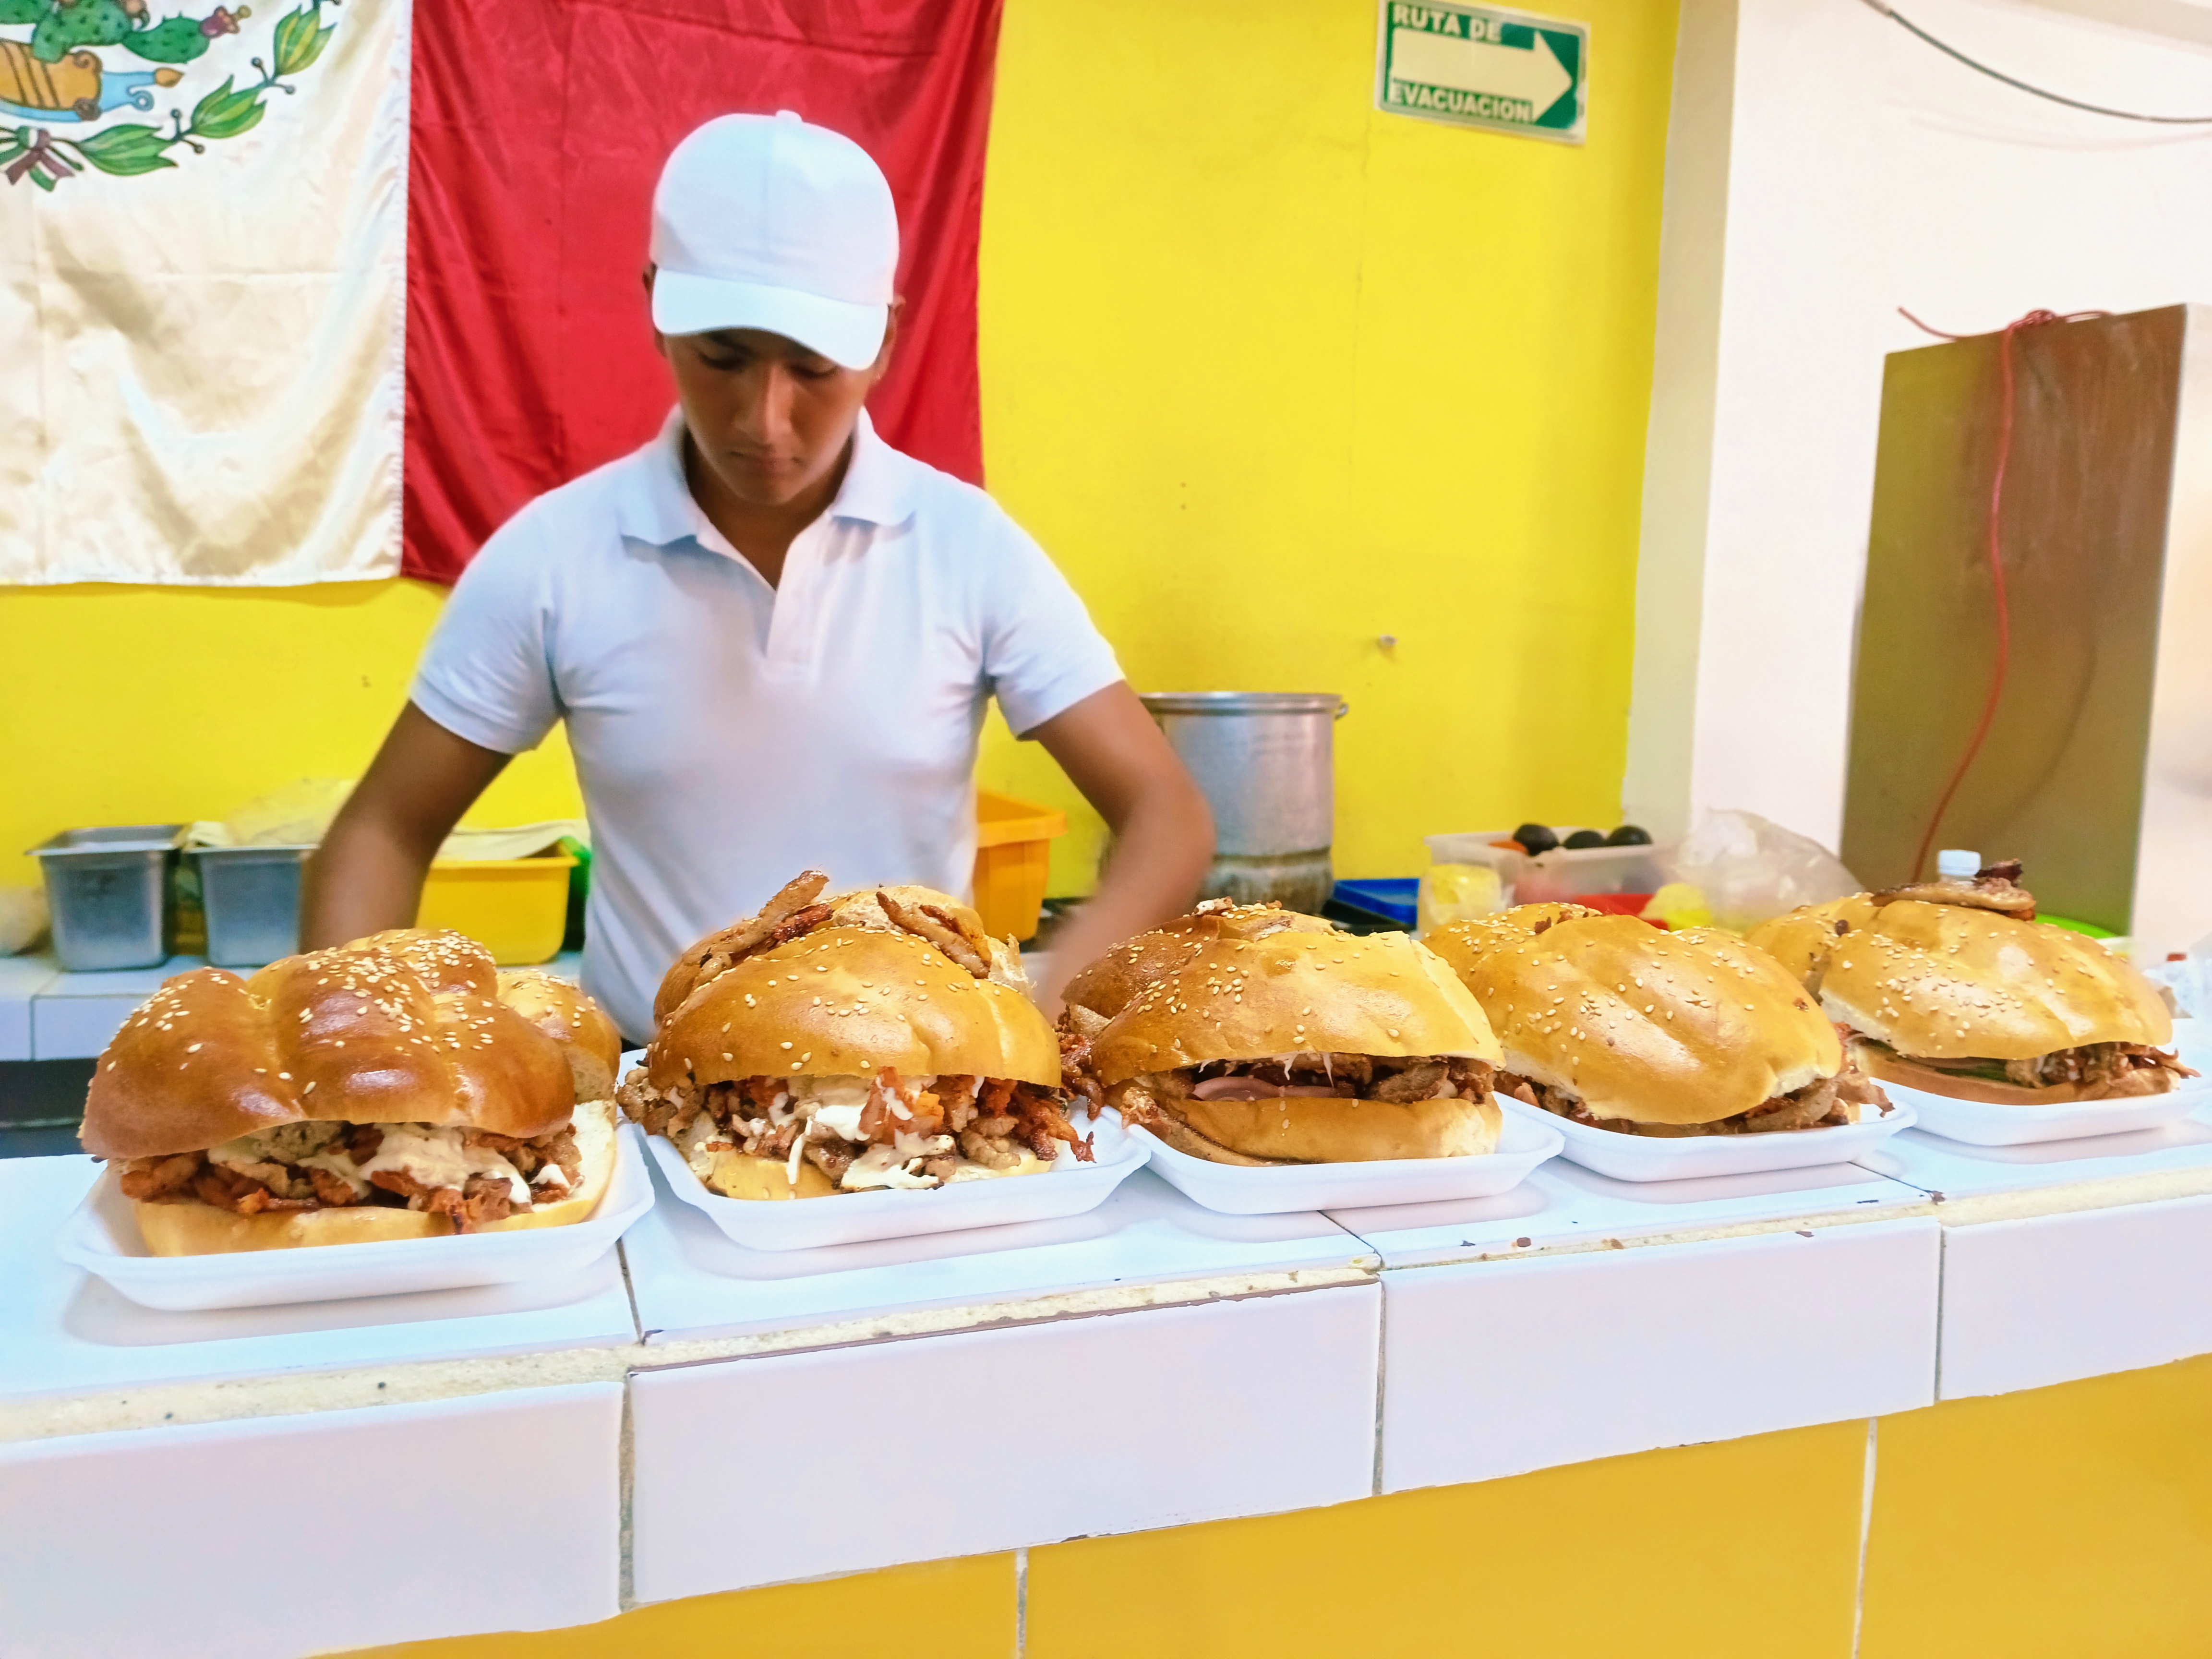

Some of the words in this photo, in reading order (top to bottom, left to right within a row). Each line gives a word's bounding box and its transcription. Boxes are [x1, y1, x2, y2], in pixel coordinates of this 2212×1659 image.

[1393, 4, 1461, 35] RUTA
[1469, 18, 1500, 42] DE
[1390, 82, 1530, 121] EVACUACION
